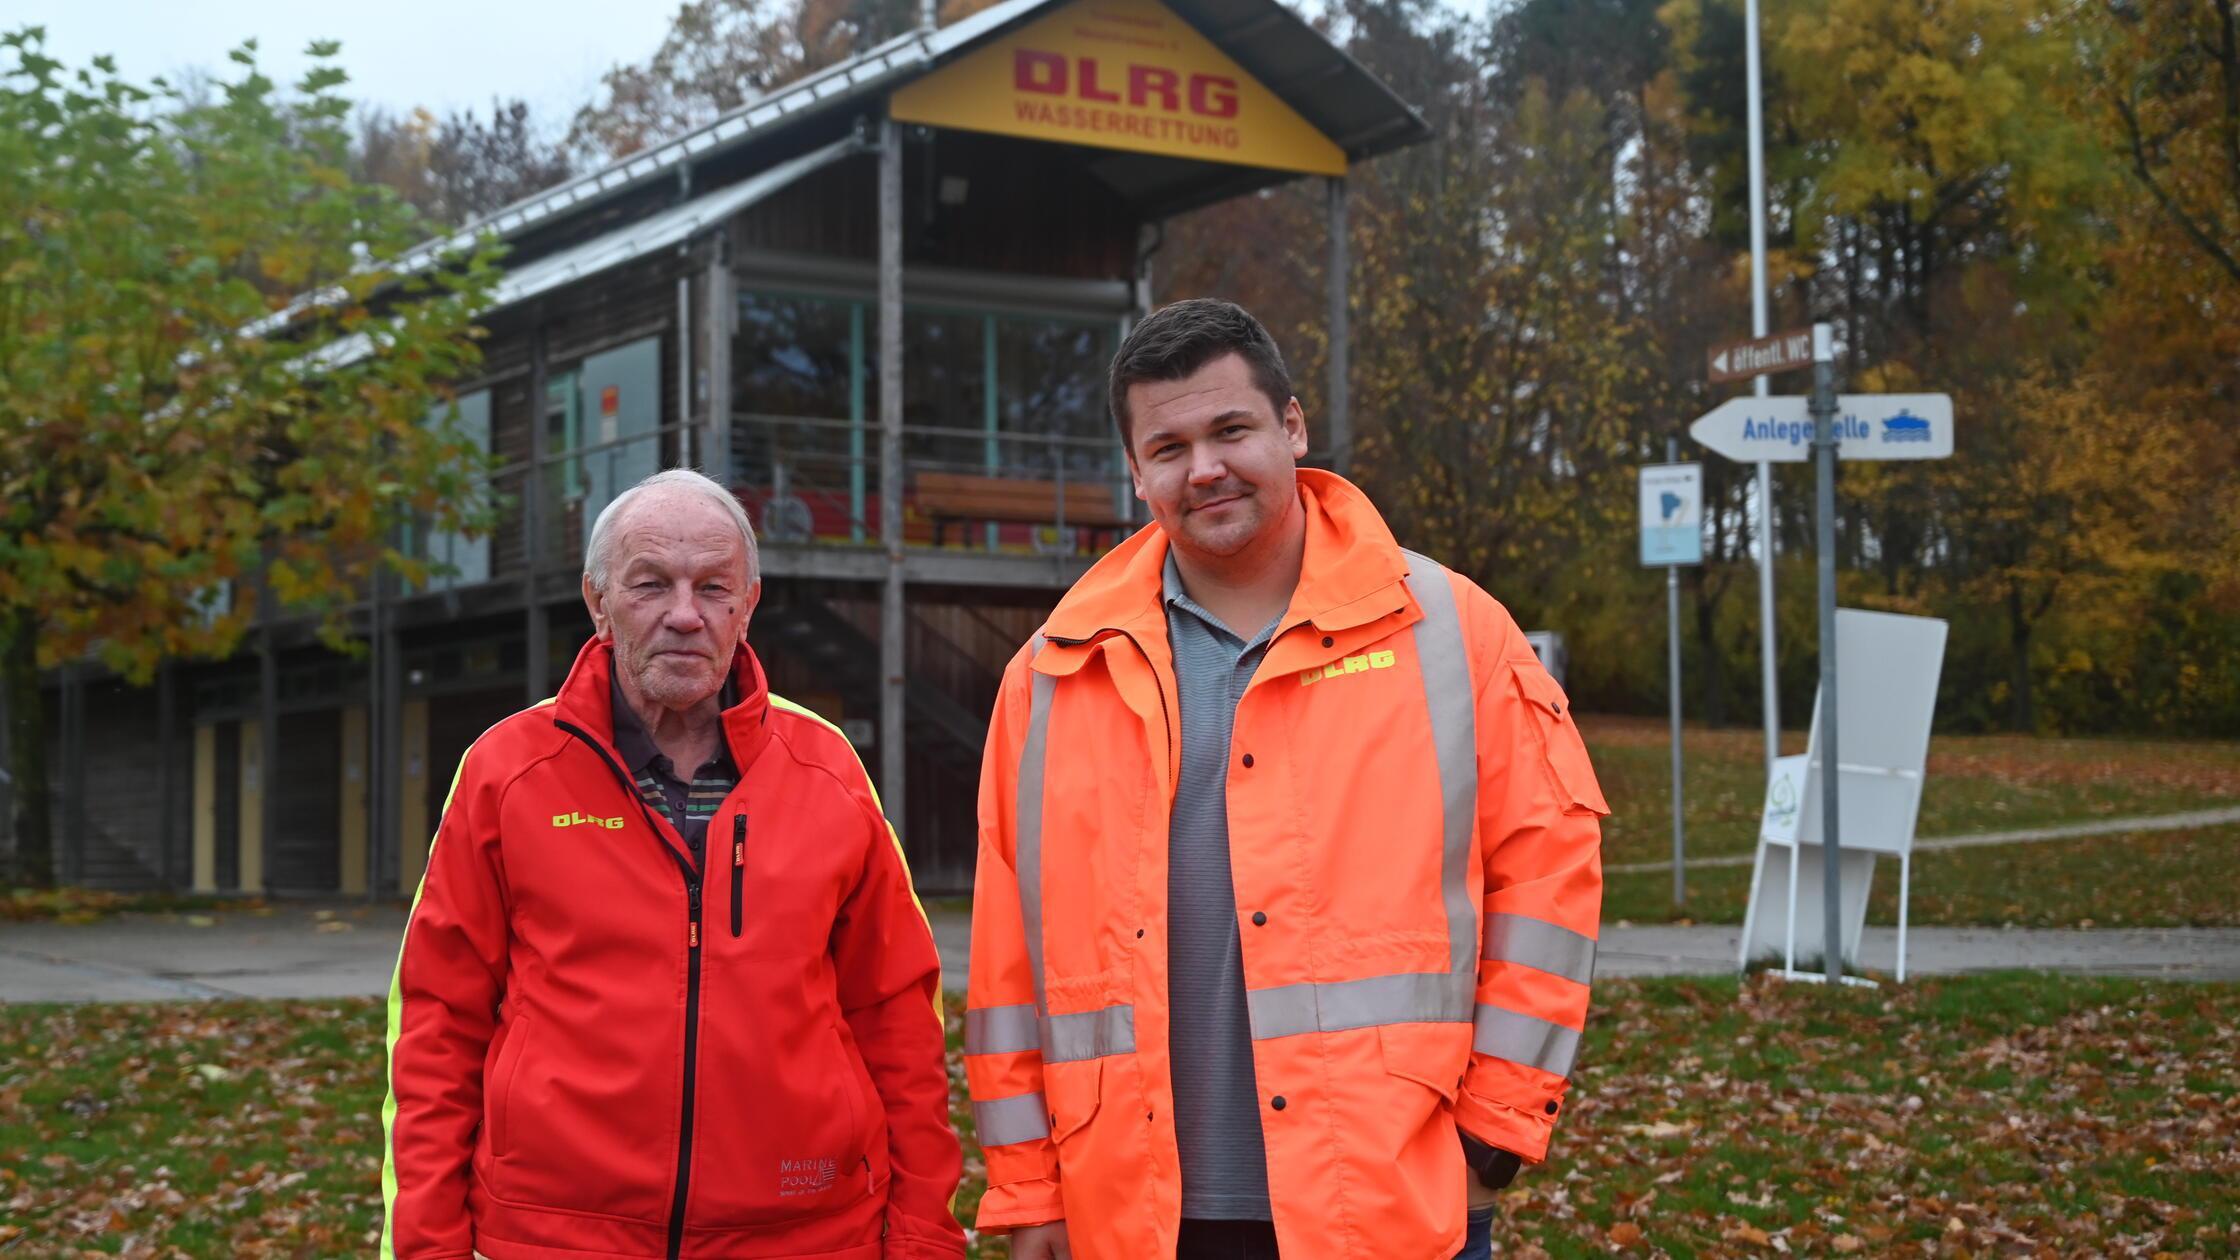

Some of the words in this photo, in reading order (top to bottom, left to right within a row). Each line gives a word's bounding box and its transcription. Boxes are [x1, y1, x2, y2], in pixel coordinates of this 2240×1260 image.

[1014, 49, 1239, 119] DLRG
[1016, 100, 1240, 149] WASSERRETTUNG
[1787, 334, 1809, 361] WC
[1743, 415, 1869, 446] Anlegeelle
[1301, 649, 1396, 687] DLRG
[552, 811, 624, 829] DLRG
